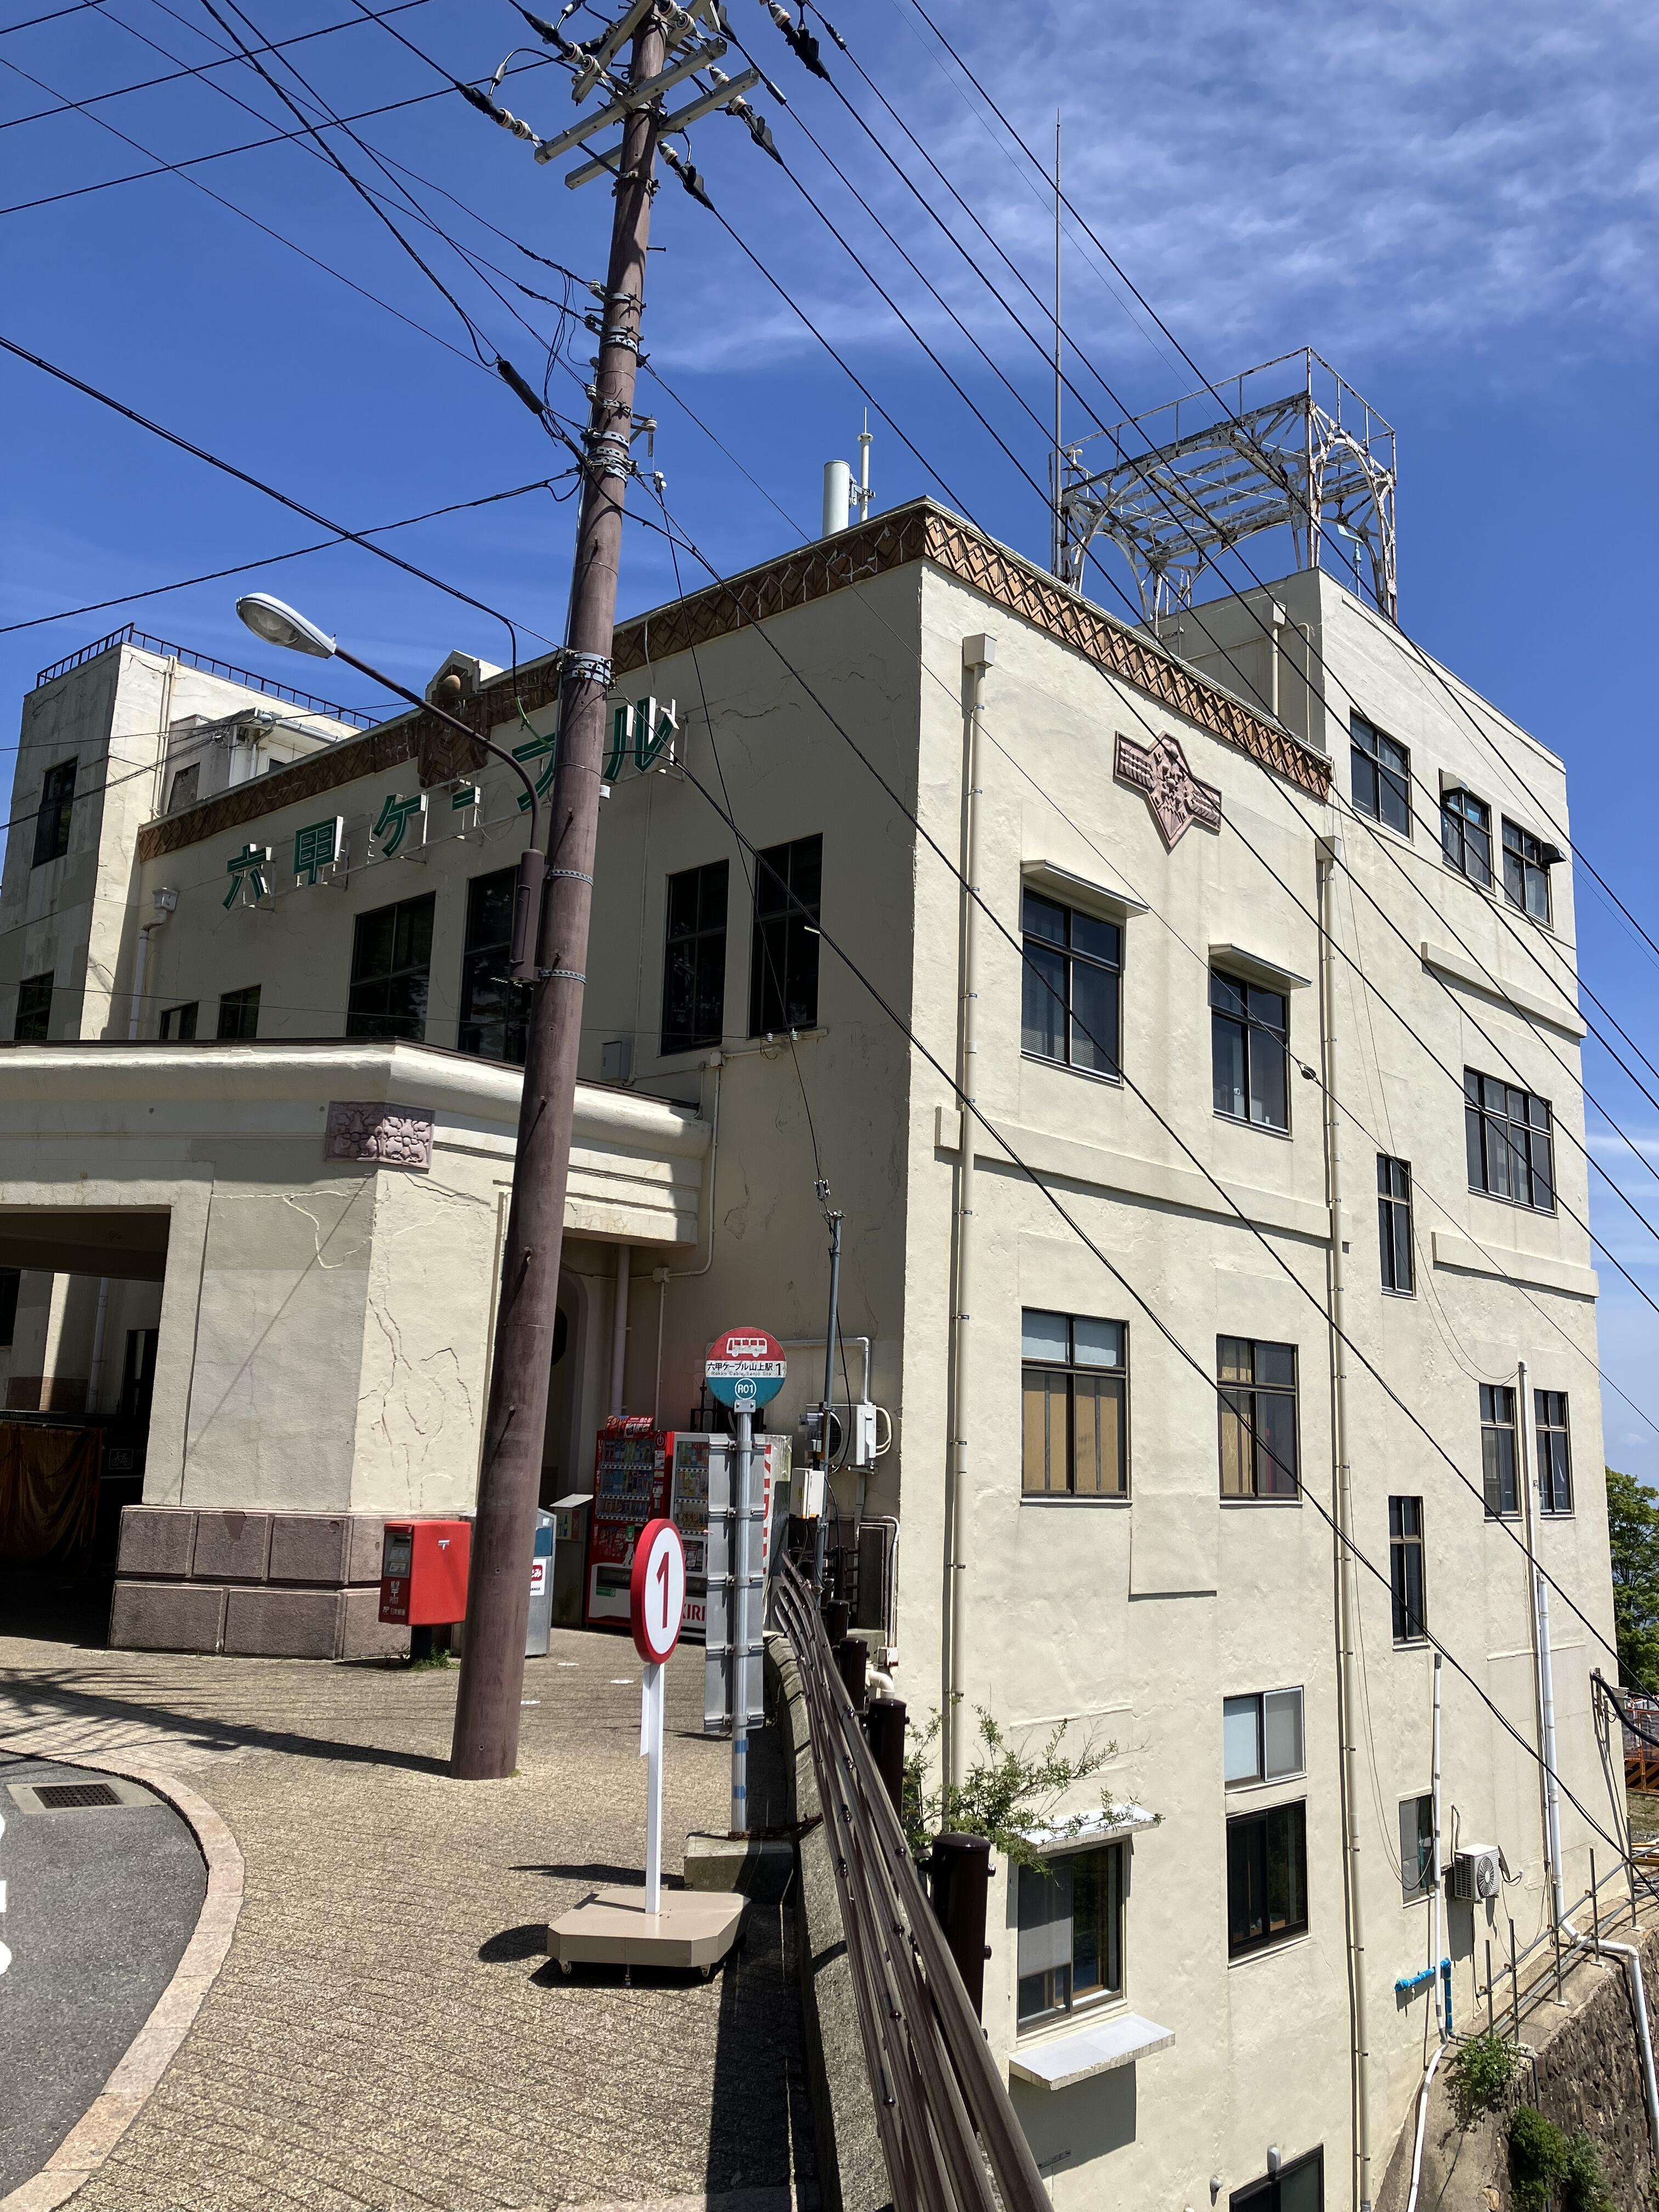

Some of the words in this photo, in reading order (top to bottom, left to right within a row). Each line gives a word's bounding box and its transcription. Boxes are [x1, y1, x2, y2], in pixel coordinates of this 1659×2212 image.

[707, 1362, 773, 1371] 六甲ケーブル山上駅
[775, 1363, 781, 1376] 1
[737, 1384, 753, 1393] R01
[656, 1551, 670, 1629] 1
